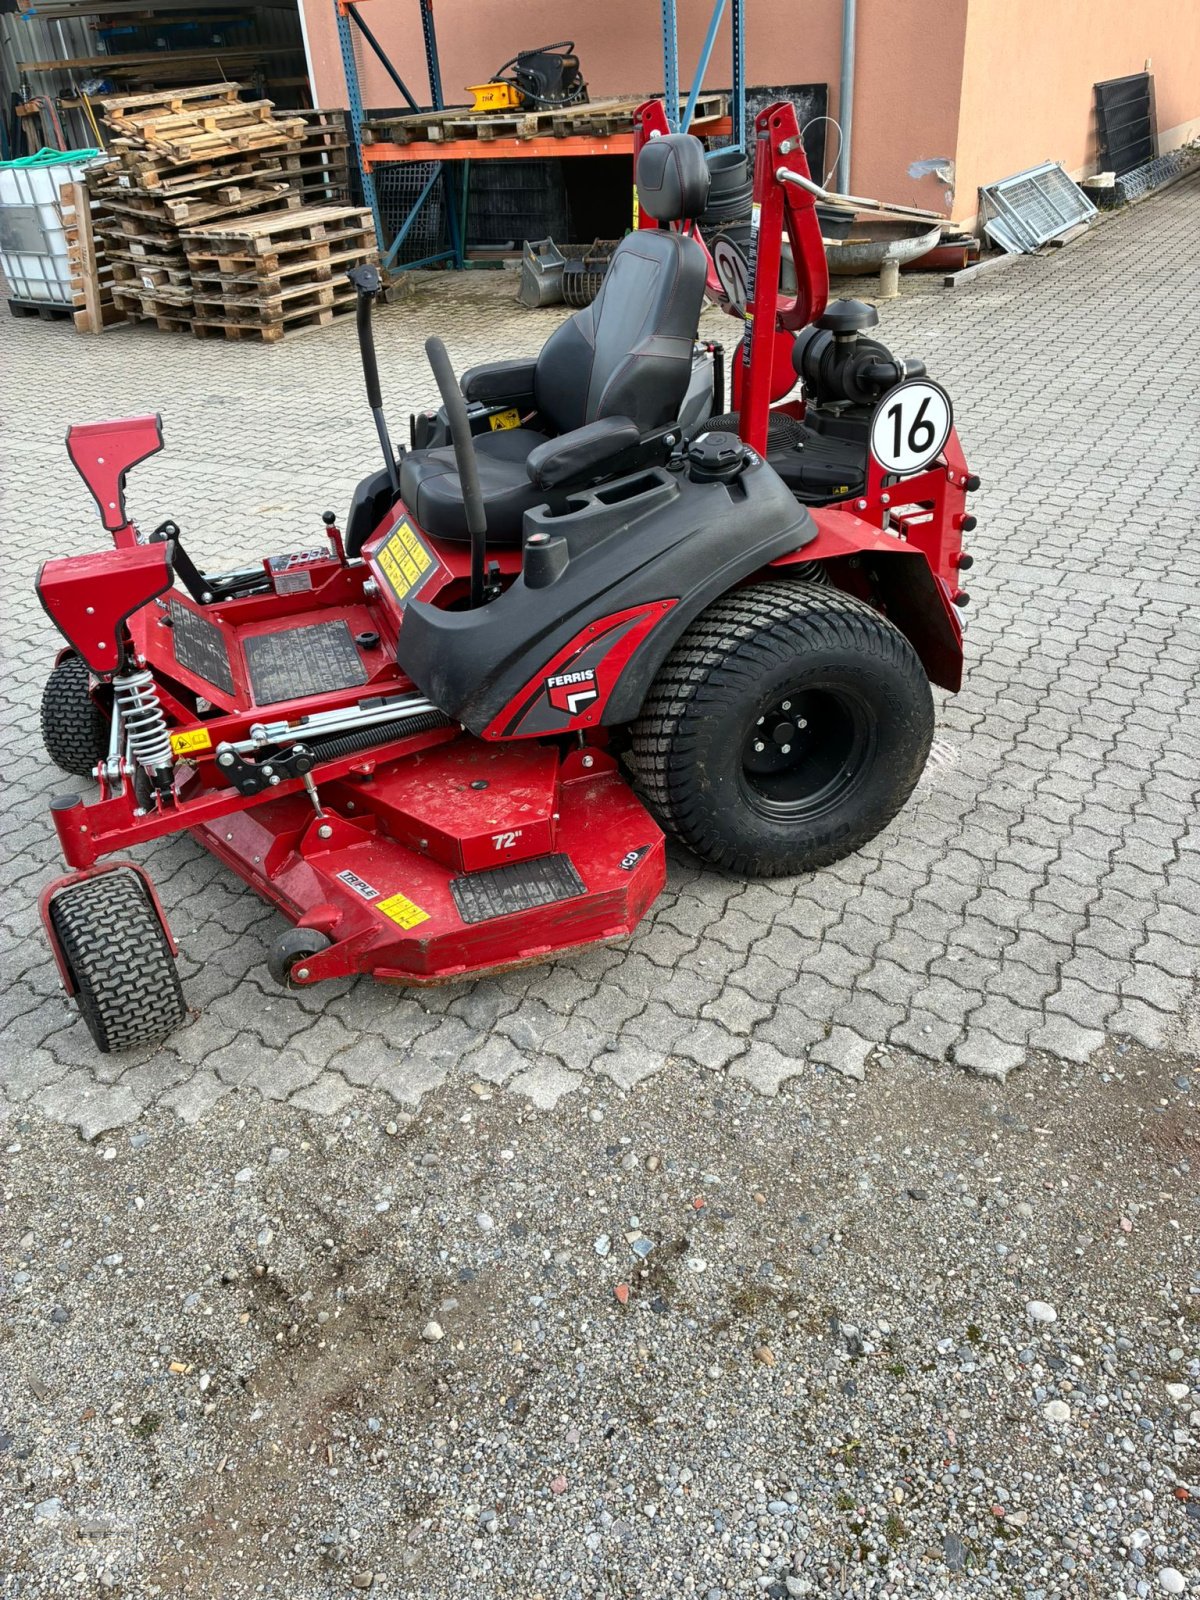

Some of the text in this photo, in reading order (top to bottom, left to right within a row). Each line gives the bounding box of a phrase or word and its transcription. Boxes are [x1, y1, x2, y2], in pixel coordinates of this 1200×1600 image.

[887, 396, 932, 459] 16
[547, 669, 595, 688] FERRIS
[491, 830, 522, 850] 72"
[342, 871, 378, 897] TRIPLE
